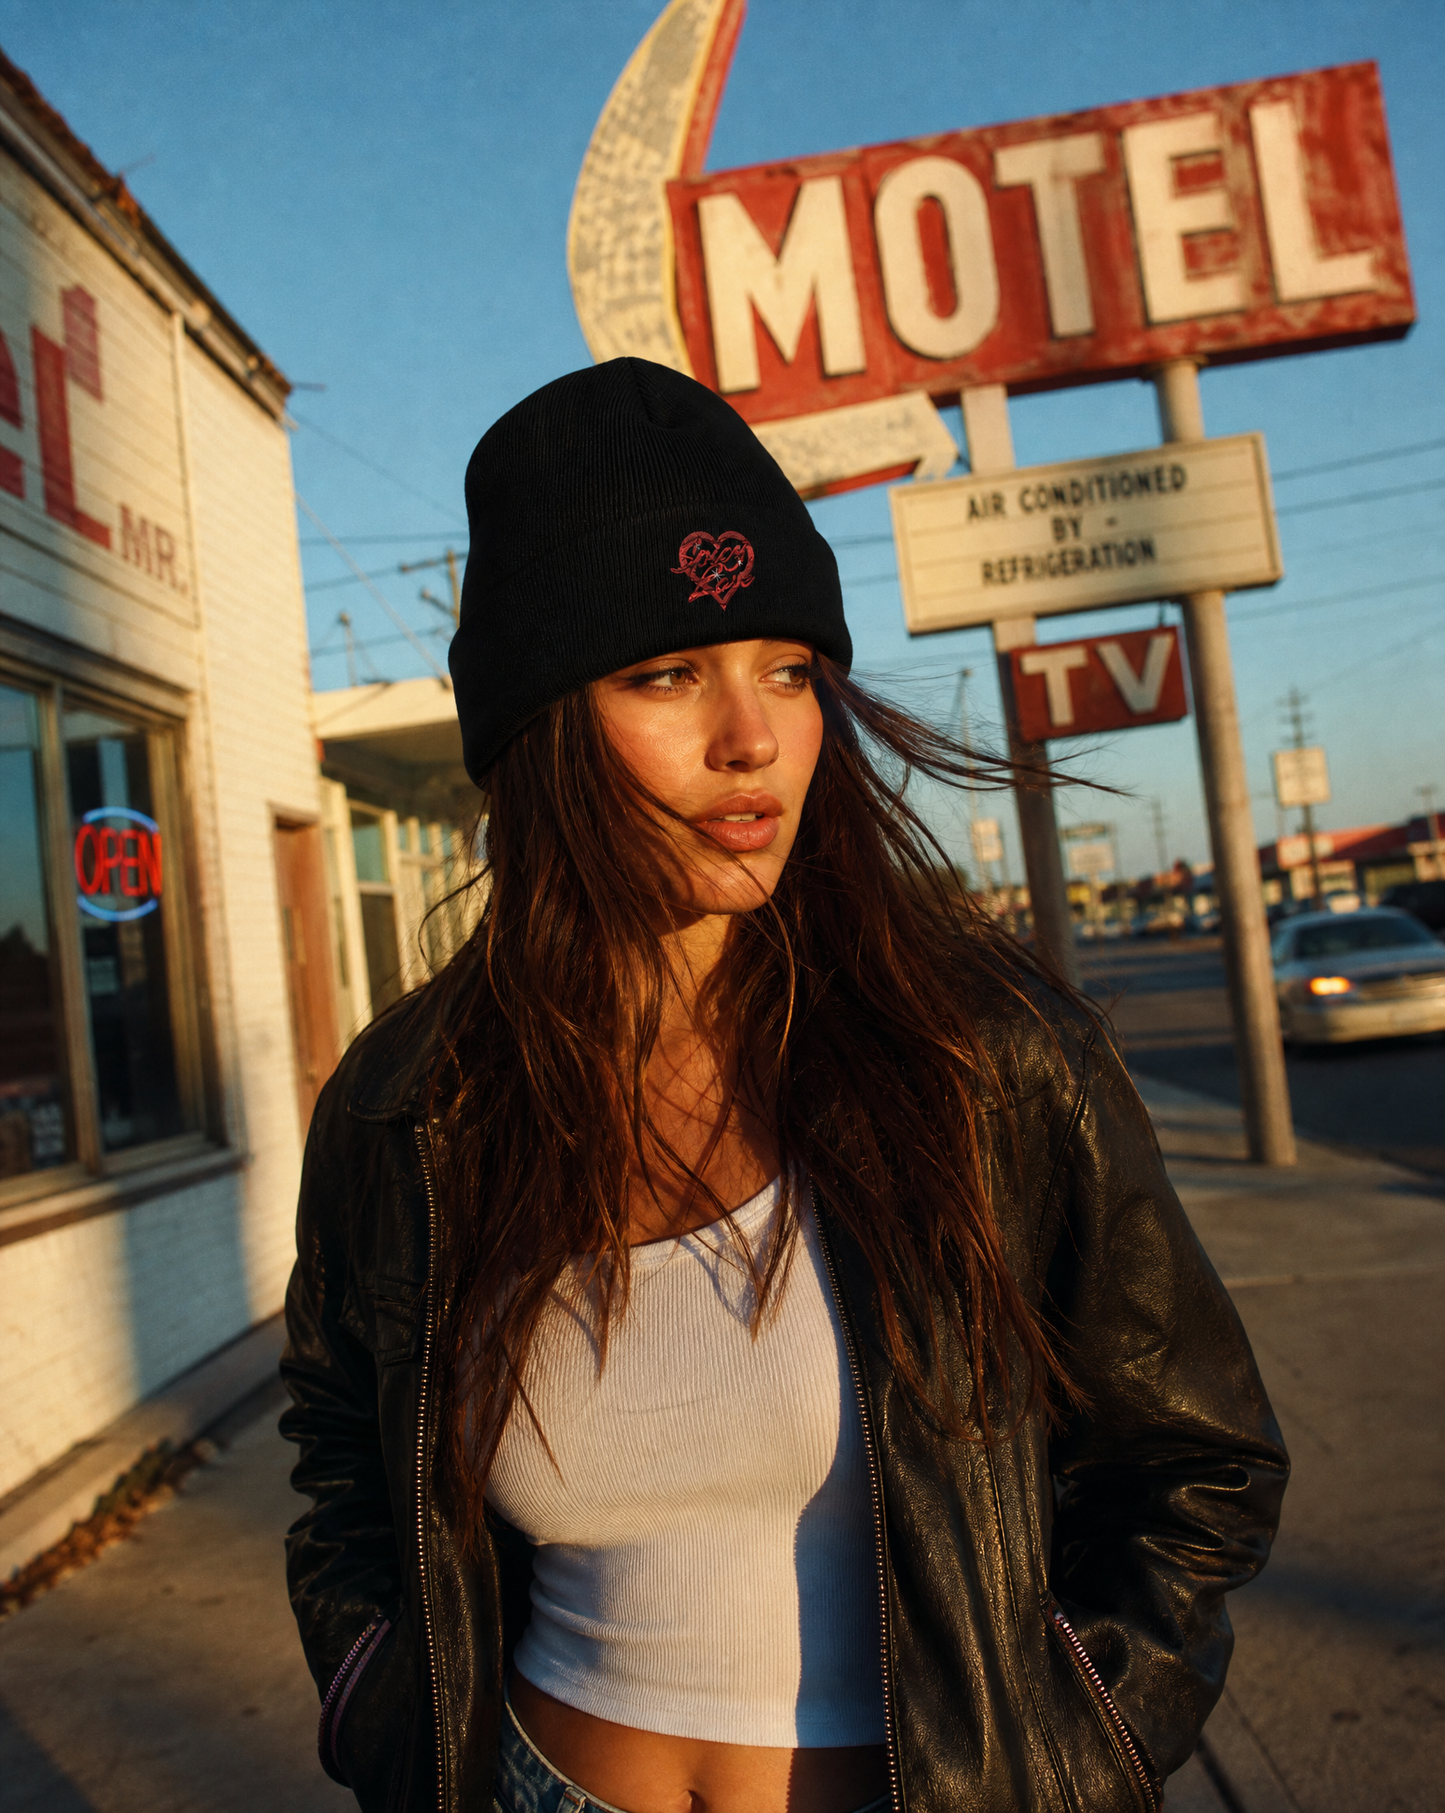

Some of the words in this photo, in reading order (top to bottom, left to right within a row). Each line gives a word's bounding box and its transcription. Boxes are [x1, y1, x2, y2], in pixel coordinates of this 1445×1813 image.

[697, 100, 1379, 394] MOTEL
[967, 492, 1006, 521] AIR
[1020, 465, 1187, 512] CONDITIONED
[1052, 516, 1083, 541] BY
[982, 539, 1155, 585] REFRIGERATION
[1019, 632, 1176, 728] TV
[74, 824, 163, 897] OPEN
